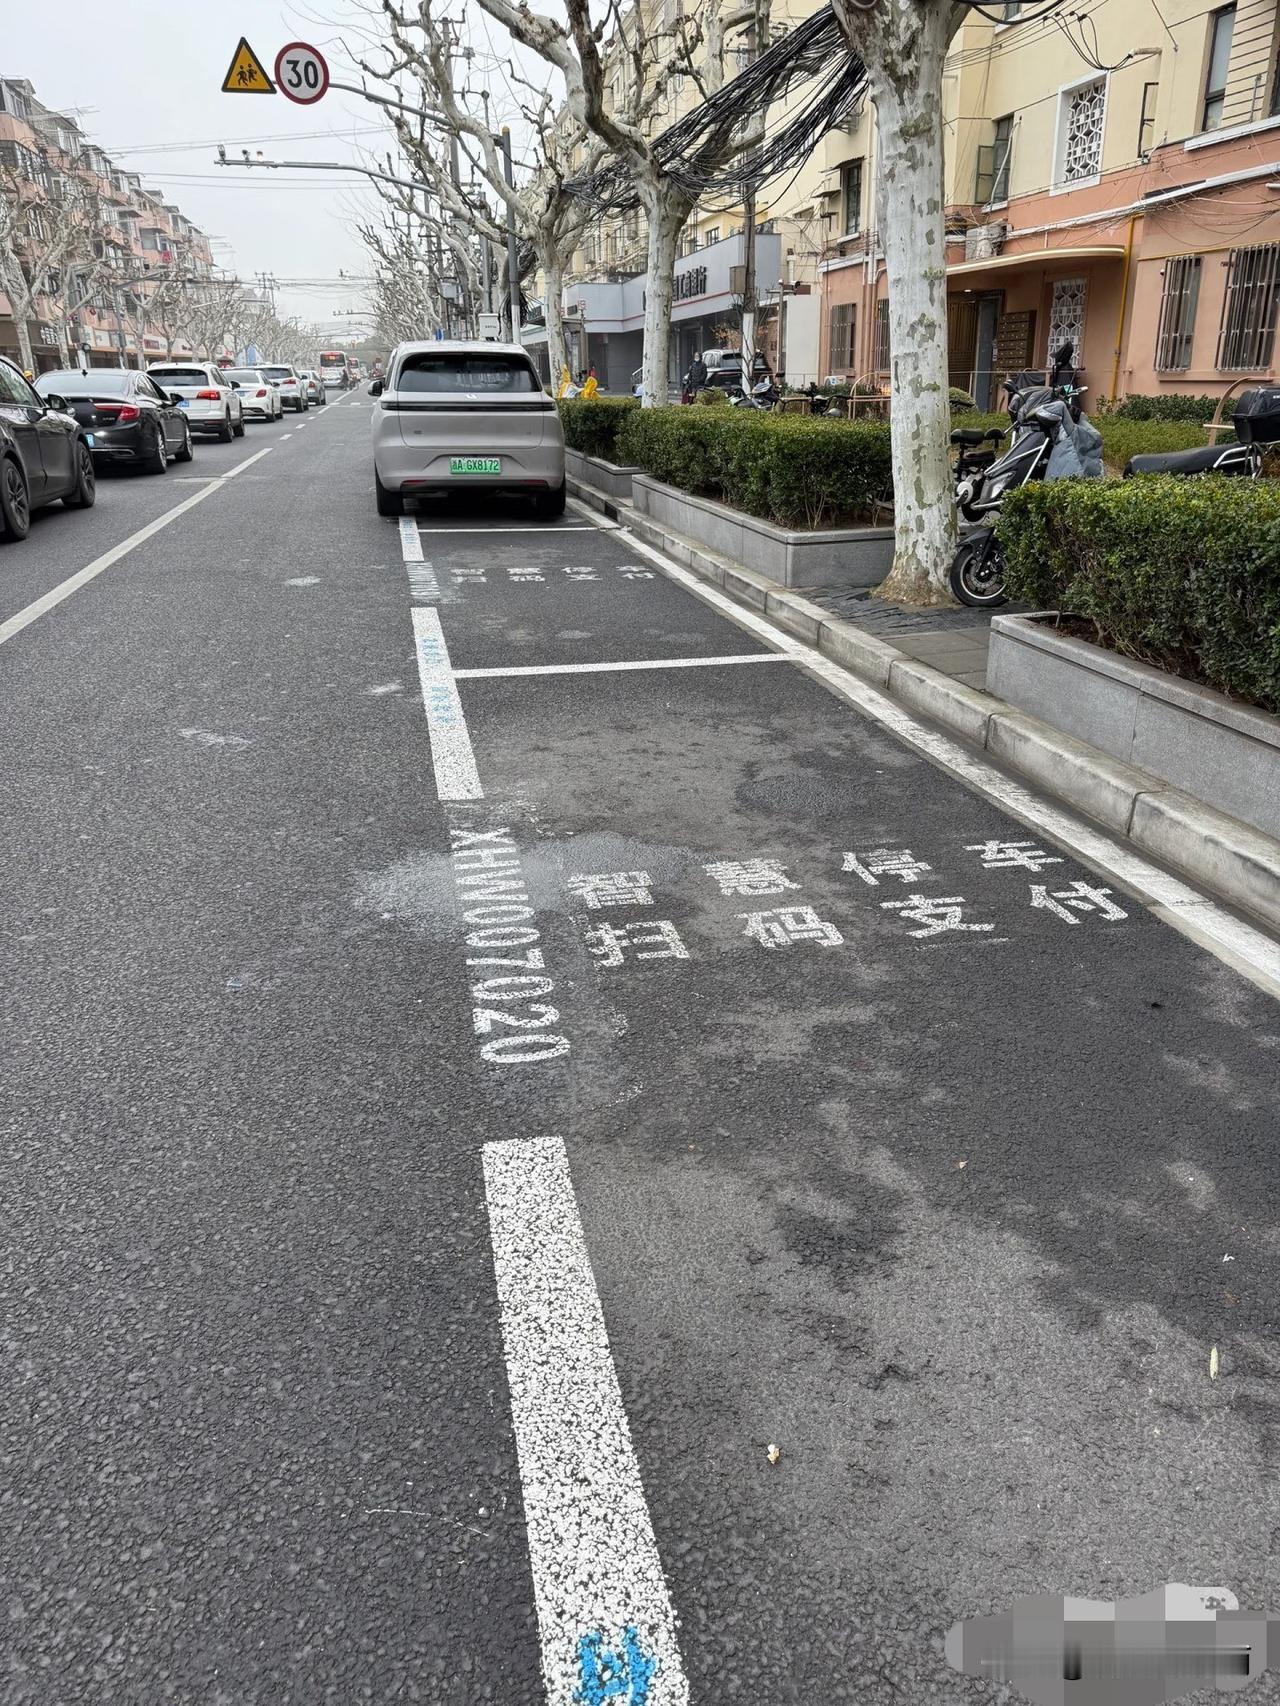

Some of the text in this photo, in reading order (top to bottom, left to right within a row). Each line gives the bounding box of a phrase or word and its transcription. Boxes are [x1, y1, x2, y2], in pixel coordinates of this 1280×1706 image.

[286, 60, 319, 89] 30
[567, 839, 1064, 910] 智慧停车
[450, 826, 571, 1065] XHW007020
[586, 880, 1130, 967] 扫码支付
